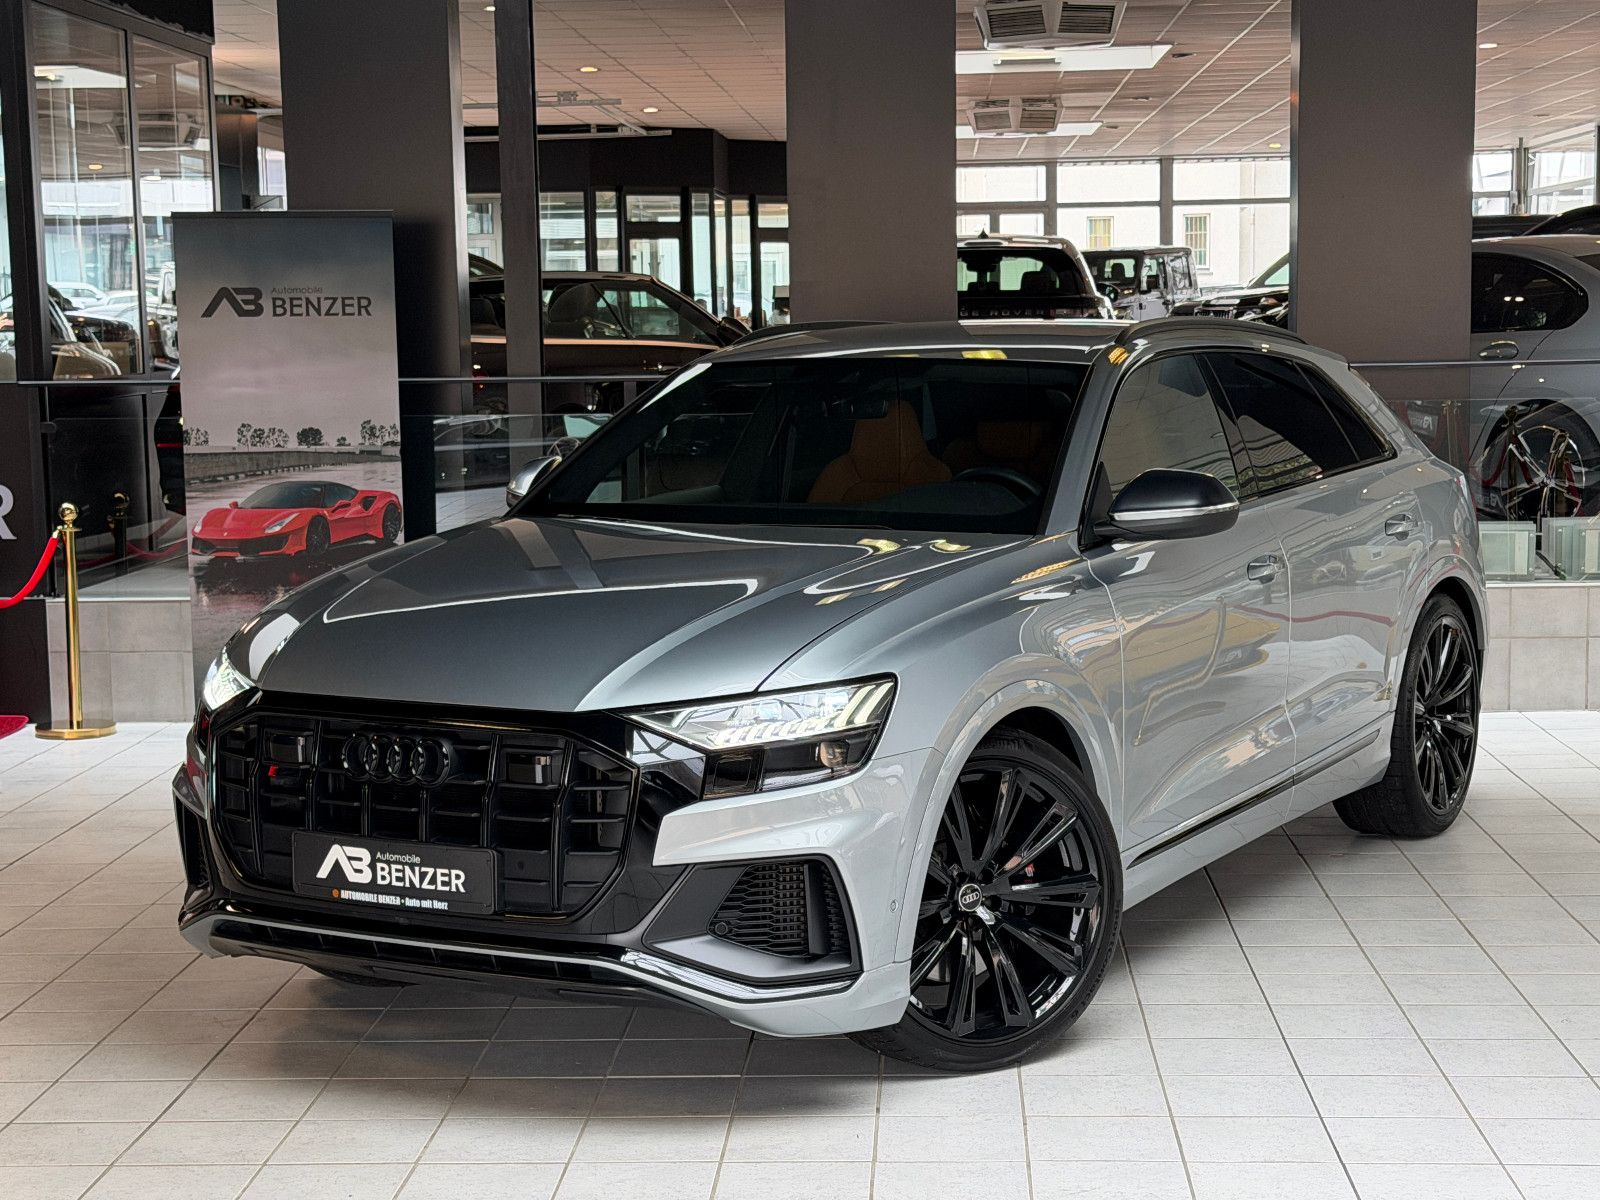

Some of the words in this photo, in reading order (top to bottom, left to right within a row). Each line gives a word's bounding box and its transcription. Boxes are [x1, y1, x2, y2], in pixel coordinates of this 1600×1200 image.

[271, 286, 323, 294] Automobile
[272, 296, 372, 318] BENZER
[376, 851, 421, 864] Automobile
[376, 862, 466, 893] BENZER
[340, 889, 378, 903] AUTOMOBILE
[378, 894, 401, 906] BENZER
[405, 897, 420, 908] Auto
[420, 900, 433, 909] mit
[433, 900, 448, 910] Herz
